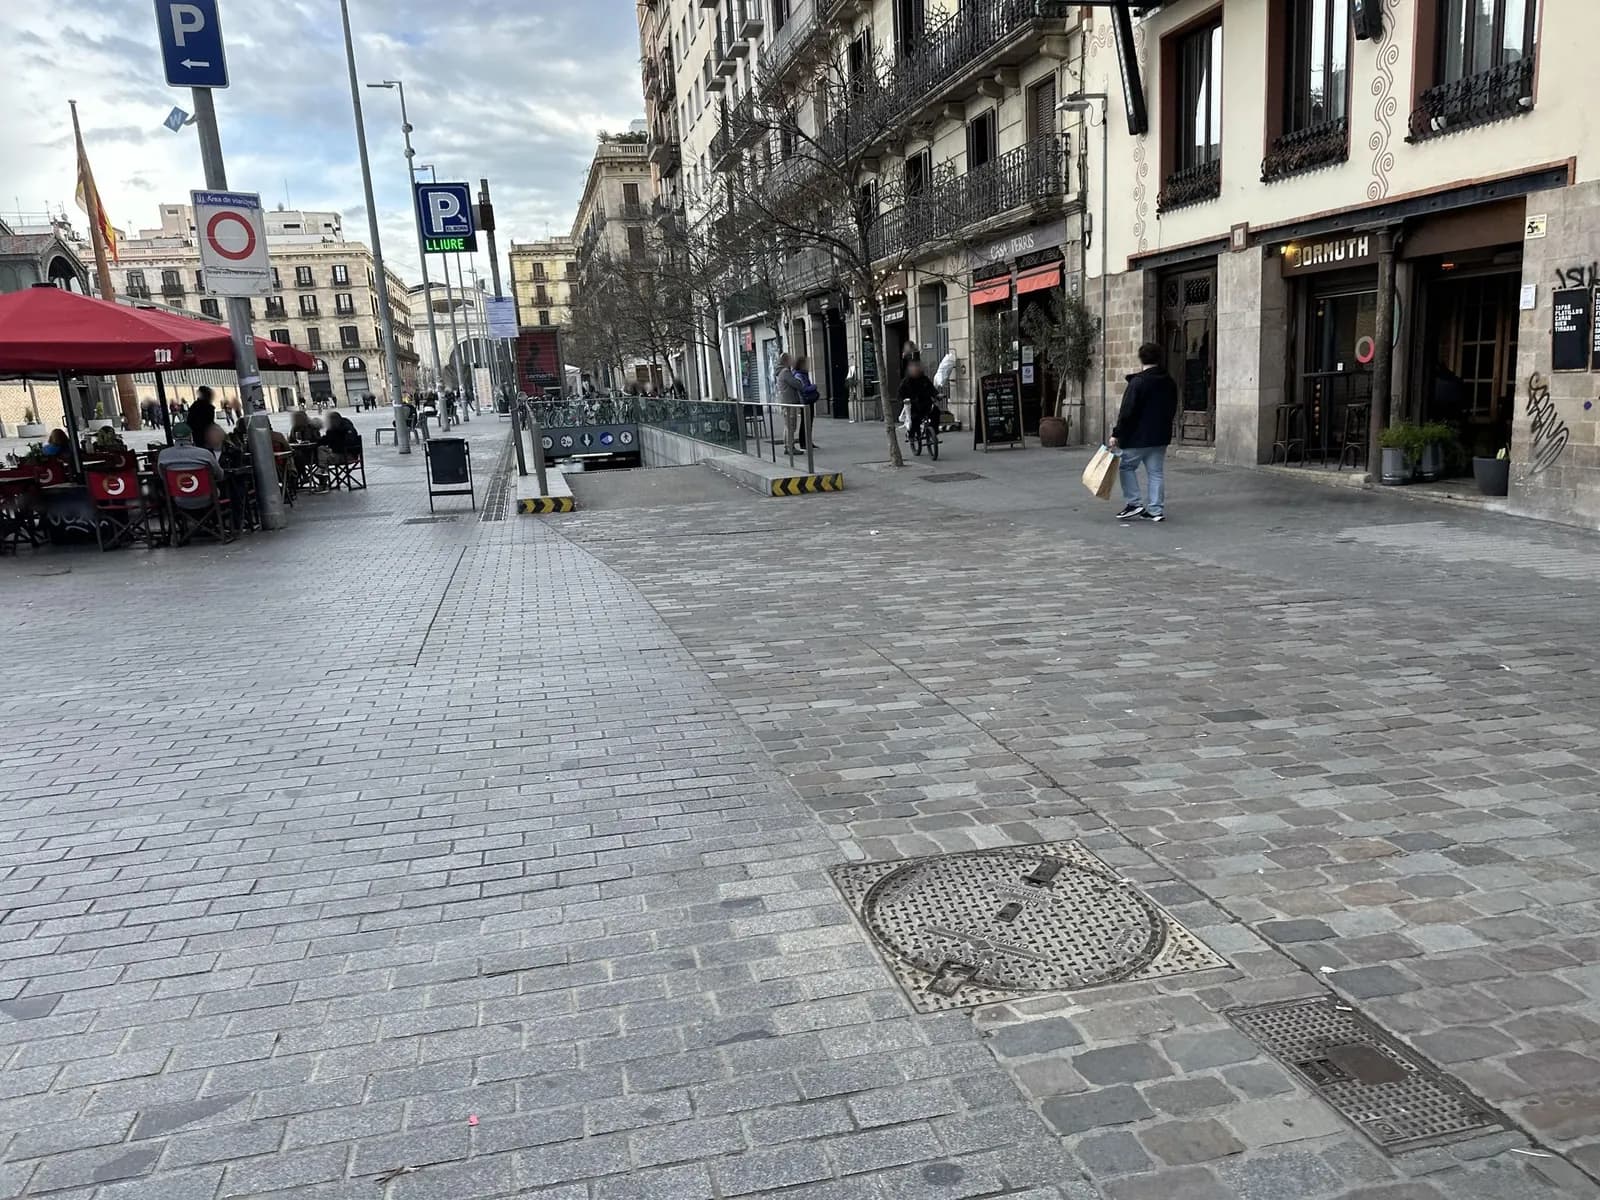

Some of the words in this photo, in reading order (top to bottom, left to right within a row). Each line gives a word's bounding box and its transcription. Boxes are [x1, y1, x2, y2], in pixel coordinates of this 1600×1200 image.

[170, 4, 205, 47] P
[428, 192, 460, 232] P
[426, 238, 464, 251] LLIURE
[1293, 235, 1369, 268] BORMUTH
